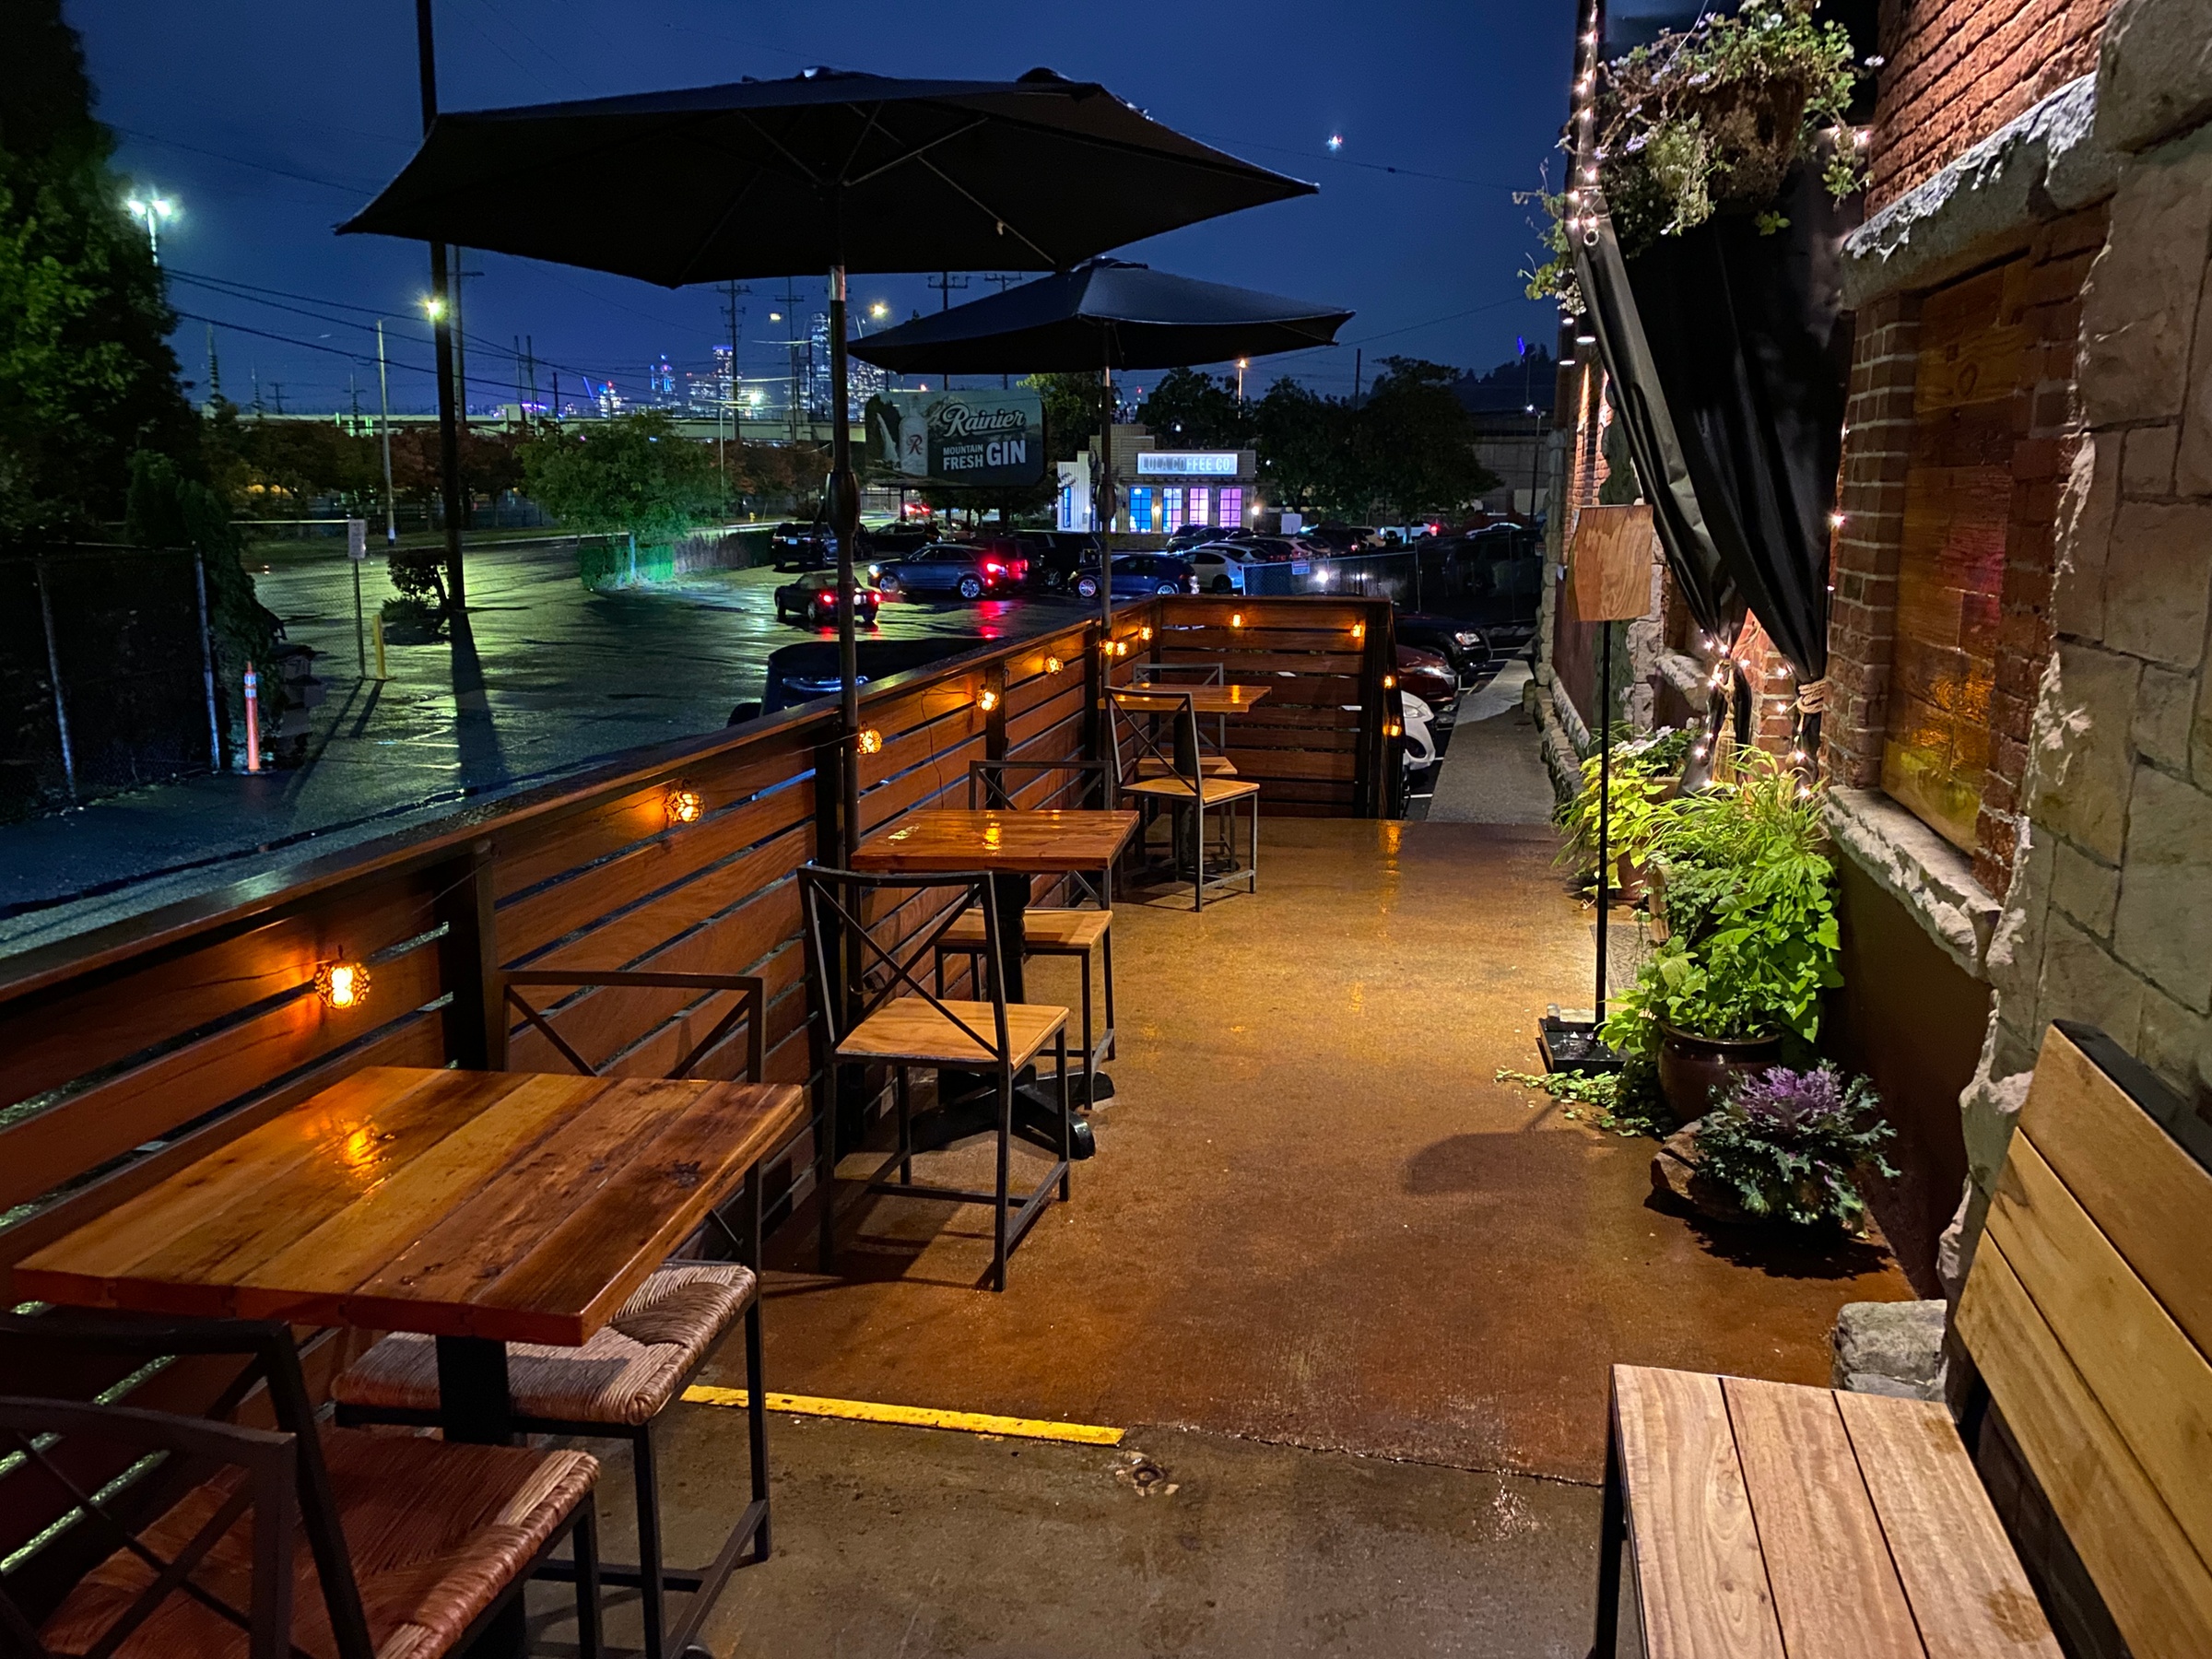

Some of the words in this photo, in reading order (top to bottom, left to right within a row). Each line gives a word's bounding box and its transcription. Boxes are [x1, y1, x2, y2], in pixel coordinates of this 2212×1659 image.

[942, 404, 1026, 437] Rainier
[907, 434, 923, 455] R
[943, 444, 983, 456] MOUNTAIN
[986, 440, 1026, 466] GIN
[943, 454, 983, 471] FRESH
[1142, 457, 1168, 471] LULA
[1171, 457, 1212, 471] COFFEE
[1216, 457, 1233, 471] CO.
